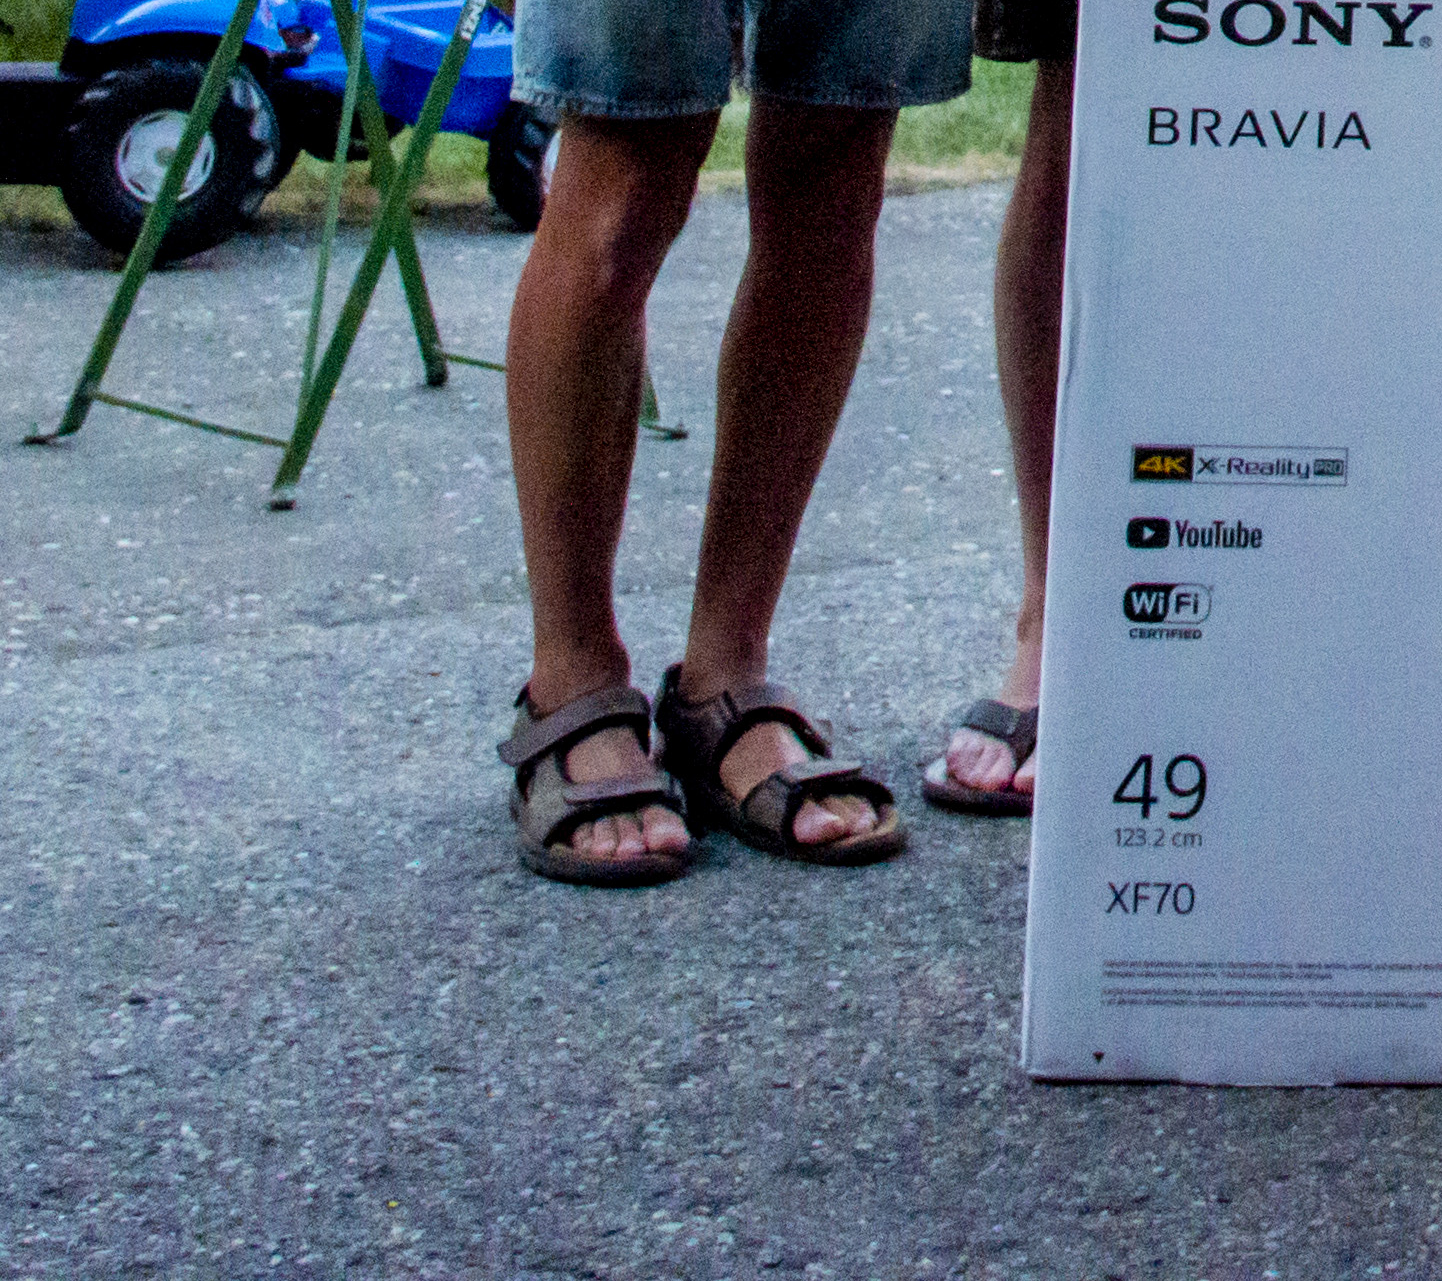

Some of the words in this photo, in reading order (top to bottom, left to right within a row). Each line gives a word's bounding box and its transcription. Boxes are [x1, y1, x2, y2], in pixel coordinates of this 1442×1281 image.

[1148, 107, 1371, 150] BRAVIA
[1137, 455, 1187, 474] 4K
[1196, 456, 1310, 479] X-Reality
[1175, 519, 1263, 549] YouTube
[1129, 627, 1203, 640] CERTIFIED
[1113, 754, 1207, 821] 49
[1114, 827, 1166, 848] 123.2
[1171, 831, 1203, 848] cm
[1106, 881, 1196, 915] XF70
